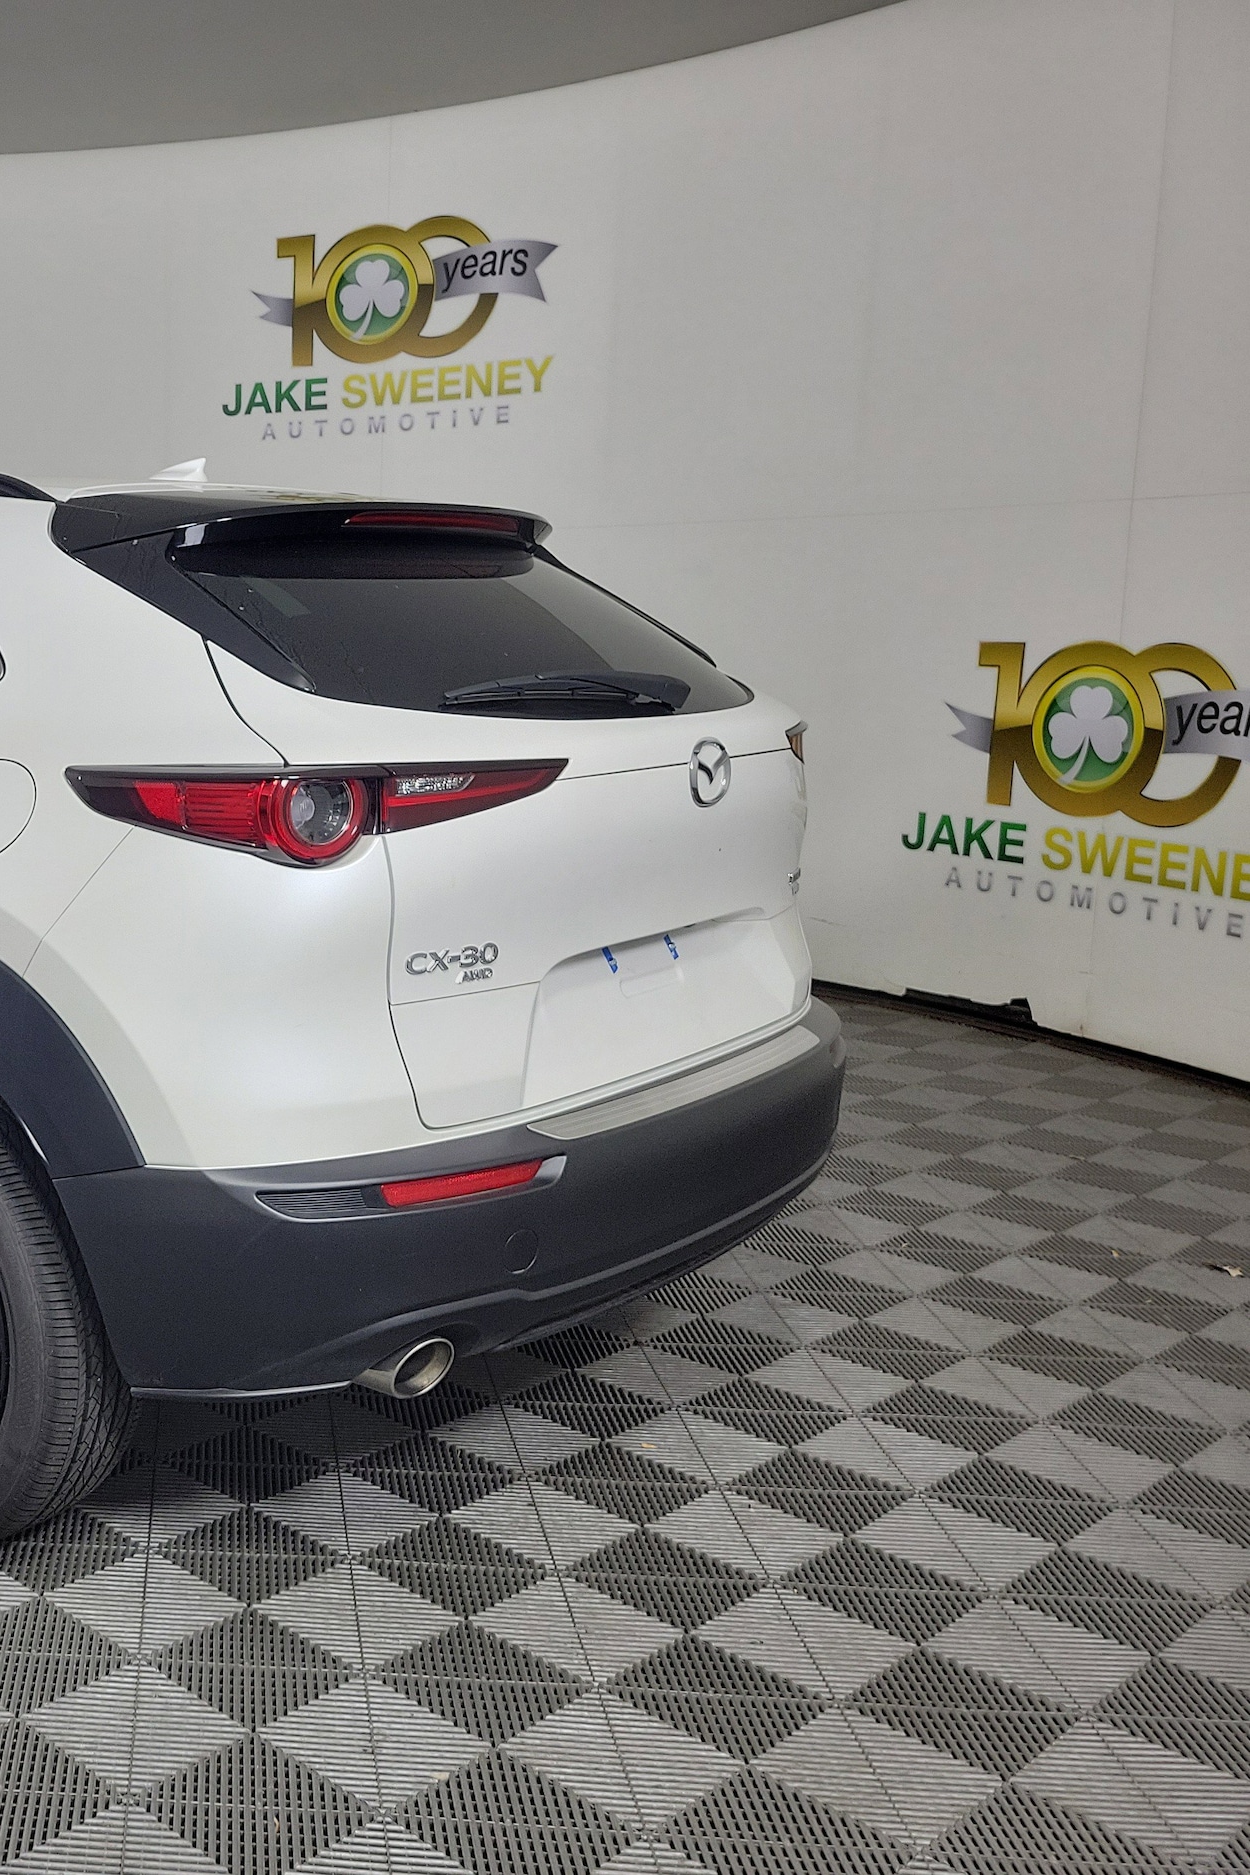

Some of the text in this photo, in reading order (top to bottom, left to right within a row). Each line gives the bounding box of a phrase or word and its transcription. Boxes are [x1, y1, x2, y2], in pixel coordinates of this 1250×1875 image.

[276, 215, 529, 367] 100 years
[222, 355, 555, 416] JAKE SWEENEY
[261, 405, 510, 441] AUTOMOTIVE
[978, 640, 1242, 828] 100
[901, 812, 1027, 865] JAKE
[944, 866, 1244, 939] AUTOMOTIVE
[405, 942, 499, 975] CX-30
[455, 967, 493, 984] AWD
